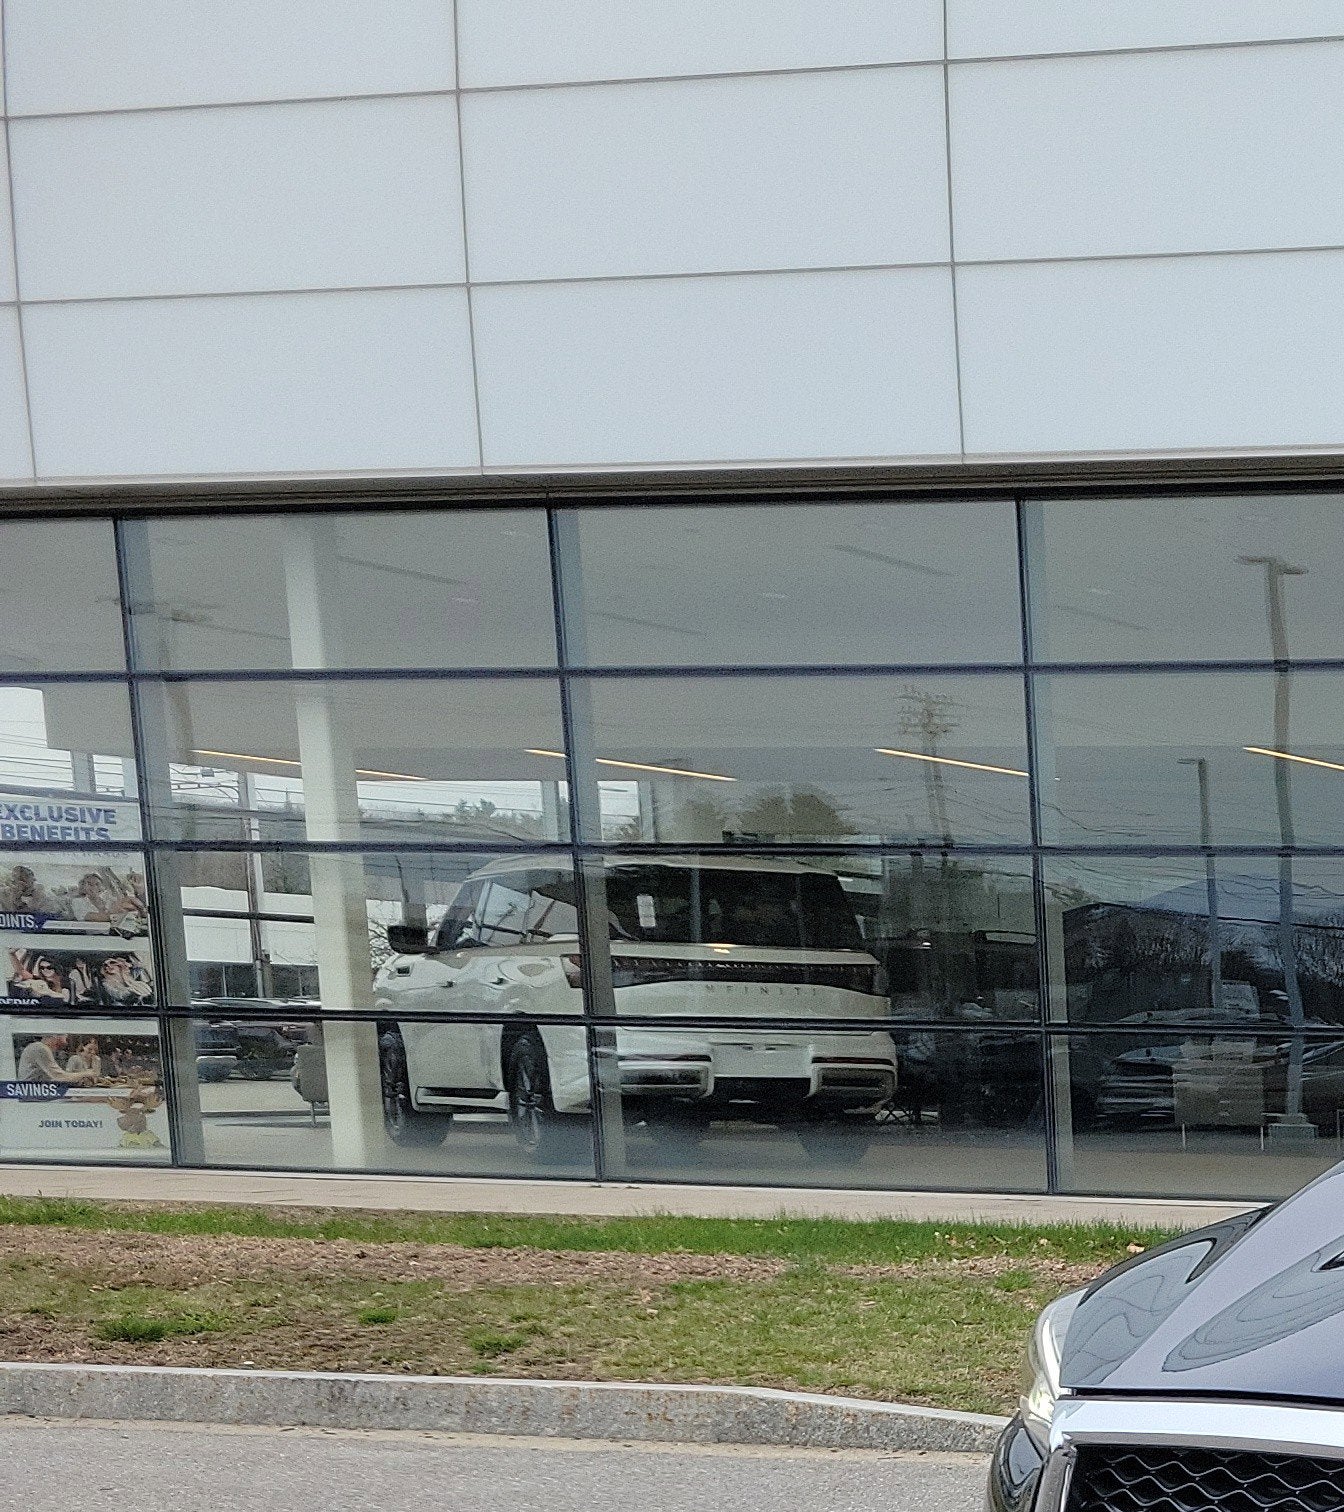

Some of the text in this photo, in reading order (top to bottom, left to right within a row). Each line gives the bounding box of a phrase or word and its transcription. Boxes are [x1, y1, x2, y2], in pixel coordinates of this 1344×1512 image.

[1, 823, 111, 841] BENEFITS
[6, 1083, 60, 1097] SAVINGS.
[39, 1120, 103, 1129] JOIN TODAY!
